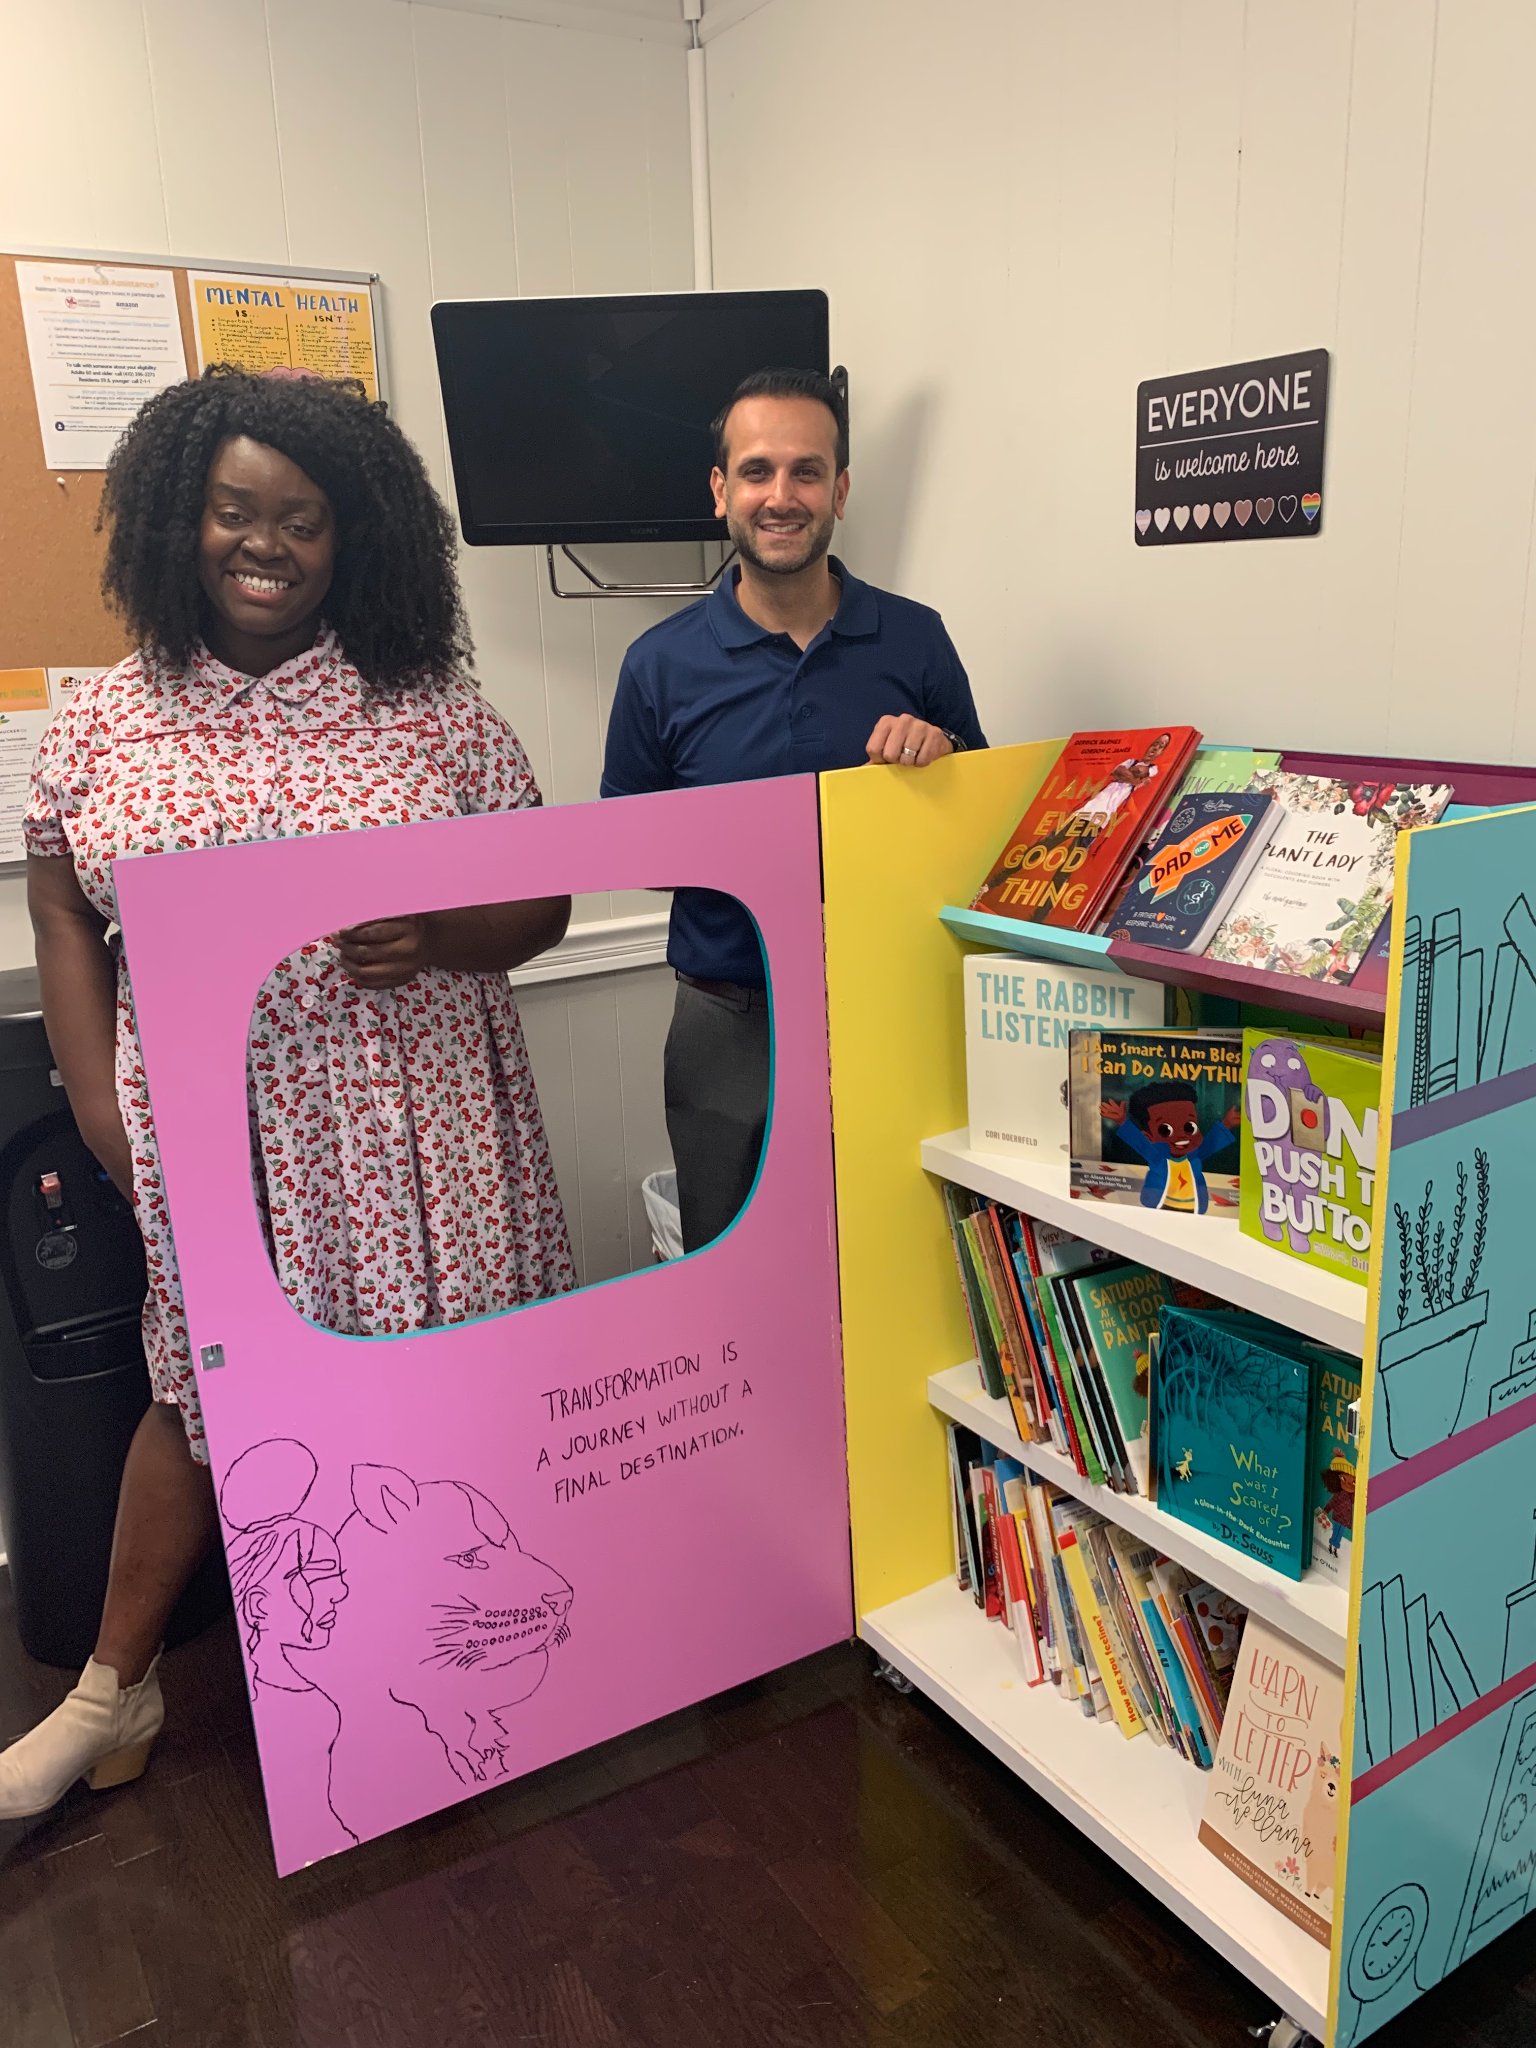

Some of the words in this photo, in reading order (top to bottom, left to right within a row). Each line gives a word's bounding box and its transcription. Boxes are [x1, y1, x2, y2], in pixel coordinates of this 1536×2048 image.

[206, 287, 286, 308] MENTAL
[296, 294, 358, 312] HEALTH
[1148, 370, 1312, 432] EVERYONE
[1154, 458, 1171, 482] is
[1175, 450, 1250, 479] welcome
[1254, 442, 1300, 470] here.
[1042, 775, 1056, 798] I
[1062, 776, 1112, 800] AM
[1033, 811, 1130, 838] EVERY
[1180, 825, 1219, 852] BETWEEN
[1305, 830, 1340, 845] THE
[1004, 844, 1089, 873] GOOD
[1154, 851, 1192, 884] DAD
[1194, 842, 1210, 855] AND
[1211, 819, 1243, 847] ME
[1313, 851, 1364, 872] LADY
[999, 878, 1088, 910] THING
[976, 972, 1026, 1008] THE
[1036, 978, 1135, 1020] RABBIT
[981, 1009, 1105, 1050] LISTEN
[1083, 1040, 1089, 1052] I
[1094, 1042, 1116, 1054] Am
[1170, 1045, 1176, 1058] I
[1180, 1046, 1206, 1059] Am
[1082, 1058, 1088, 1073] I
[1094, 1058, 1126, 1076] Can
[1132, 1063, 1154, 1078] Do
[985, 1130, 1000, 1140] CORI
[1001, 1132, 1038, 1146] DOERRFELD
[1254, 1141, 1346, 1198] PUSH
[1090, 1272, 1162, 1308] SATURDAY
[1099, 1317, 1117, 1330] THE
[1118, 1295, 1165, 1322] FOOD
[541, 1354, 700, 1422] TRANSFORMATION
[722, 1342, 738, 1364] IS
[536, 1448, 551, 1472] A
[562, 1416, 646, 1460] JOURNEY
[658, 1383, 730, 1427] WITHOUT
[742, 1379, 753, 1398] A
[554, 1471, 611, 1504] FINAL
[620, 1422, 744, 1481] DESTINATION.
[1230, 1444, 1278, 1478] What
[1230, 1482, 1278, 1517] Scared
[1244, 1478, 1267, 1493] was
[1272, 1487, 1279, 1499] I
[1194, 1498, 1200, 1506] A
[1256, 1531, 1290, 1550] Encounter
[1220, 1523, 1240, 1544] Dr.
[1240, 1533, 1274, 1564] Seuss
[1109, 1657, 1121, 1677] you
[1248, 1648, 1319, 1720] LEARN
[1117, 1680, 1127, 1696] are
[1124, 1698, 1137, 1723] How
[1266, 1713, 1286, 1732] TO
[1234, 1710, 1312, 1793] LETTER
[1219, 1756, 1242, 1782] WITH
[1232, 1776, 1289, 1820] luna
[1214, 1792, 1250, 1825] the
[1250, 1806, 1313, 1857] llama
[1223, 1852, 1254, 1880] BESTSELLING
[1255, 1880, 1275, 1898] AUTHOR
[1236, 1856, 1279, 1893] HAND-LETTERING
[1280, 1892, 1312, 1919] WORKBOOK
